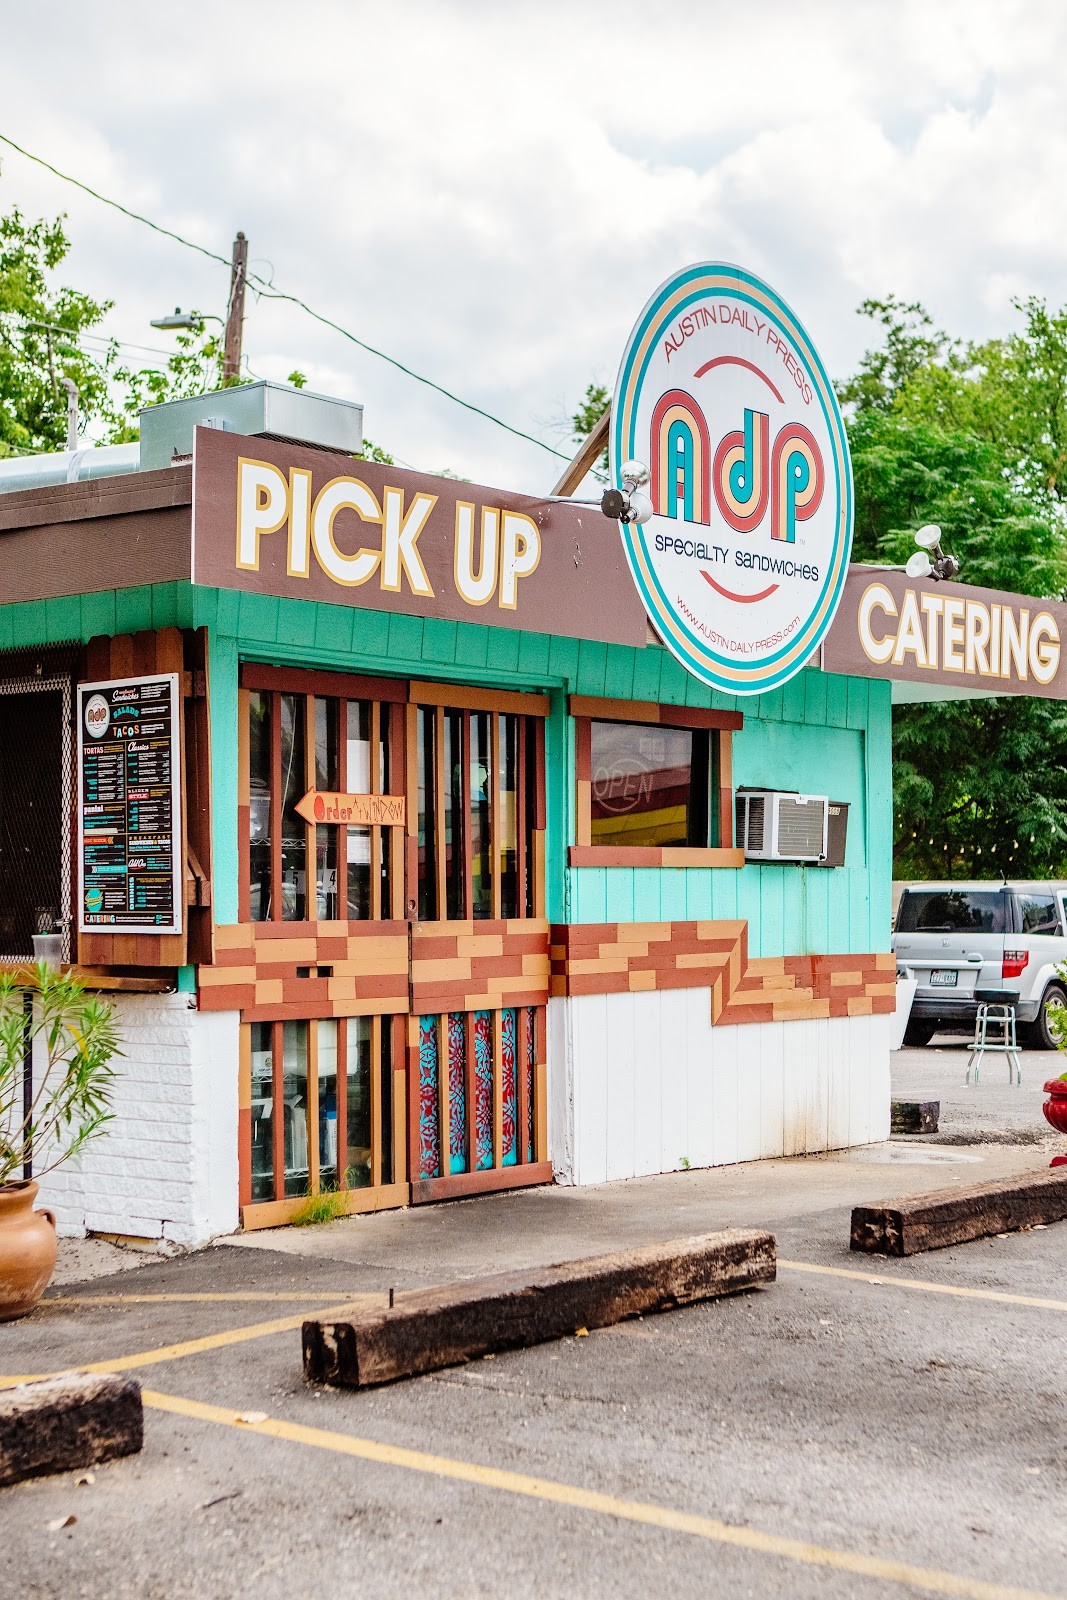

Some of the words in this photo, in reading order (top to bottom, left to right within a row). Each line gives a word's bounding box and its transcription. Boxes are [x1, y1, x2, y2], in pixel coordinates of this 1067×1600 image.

[664, 304, 717, 364] AUSTIN
[719, 304, 766, 336] DAILY
[766, 328, 813, 405] PRESS
[236, 456, 439, 598] PICK
[453, 499, 541, 610] UP
[858, 583, 1061, 684] CATERING
[113, 707, 139, 718] SALADS
[113, 725, 139, 738] TACOS
[84, 747, 103, 755] TORTAS
[128, 742, 149, 752] Classics
[593, 766, 654, 803] OPEN
[314, 795, 353, 820] Order
[329, 870, 336, 886] 4
[85, 915, 115, 923] CATERING
